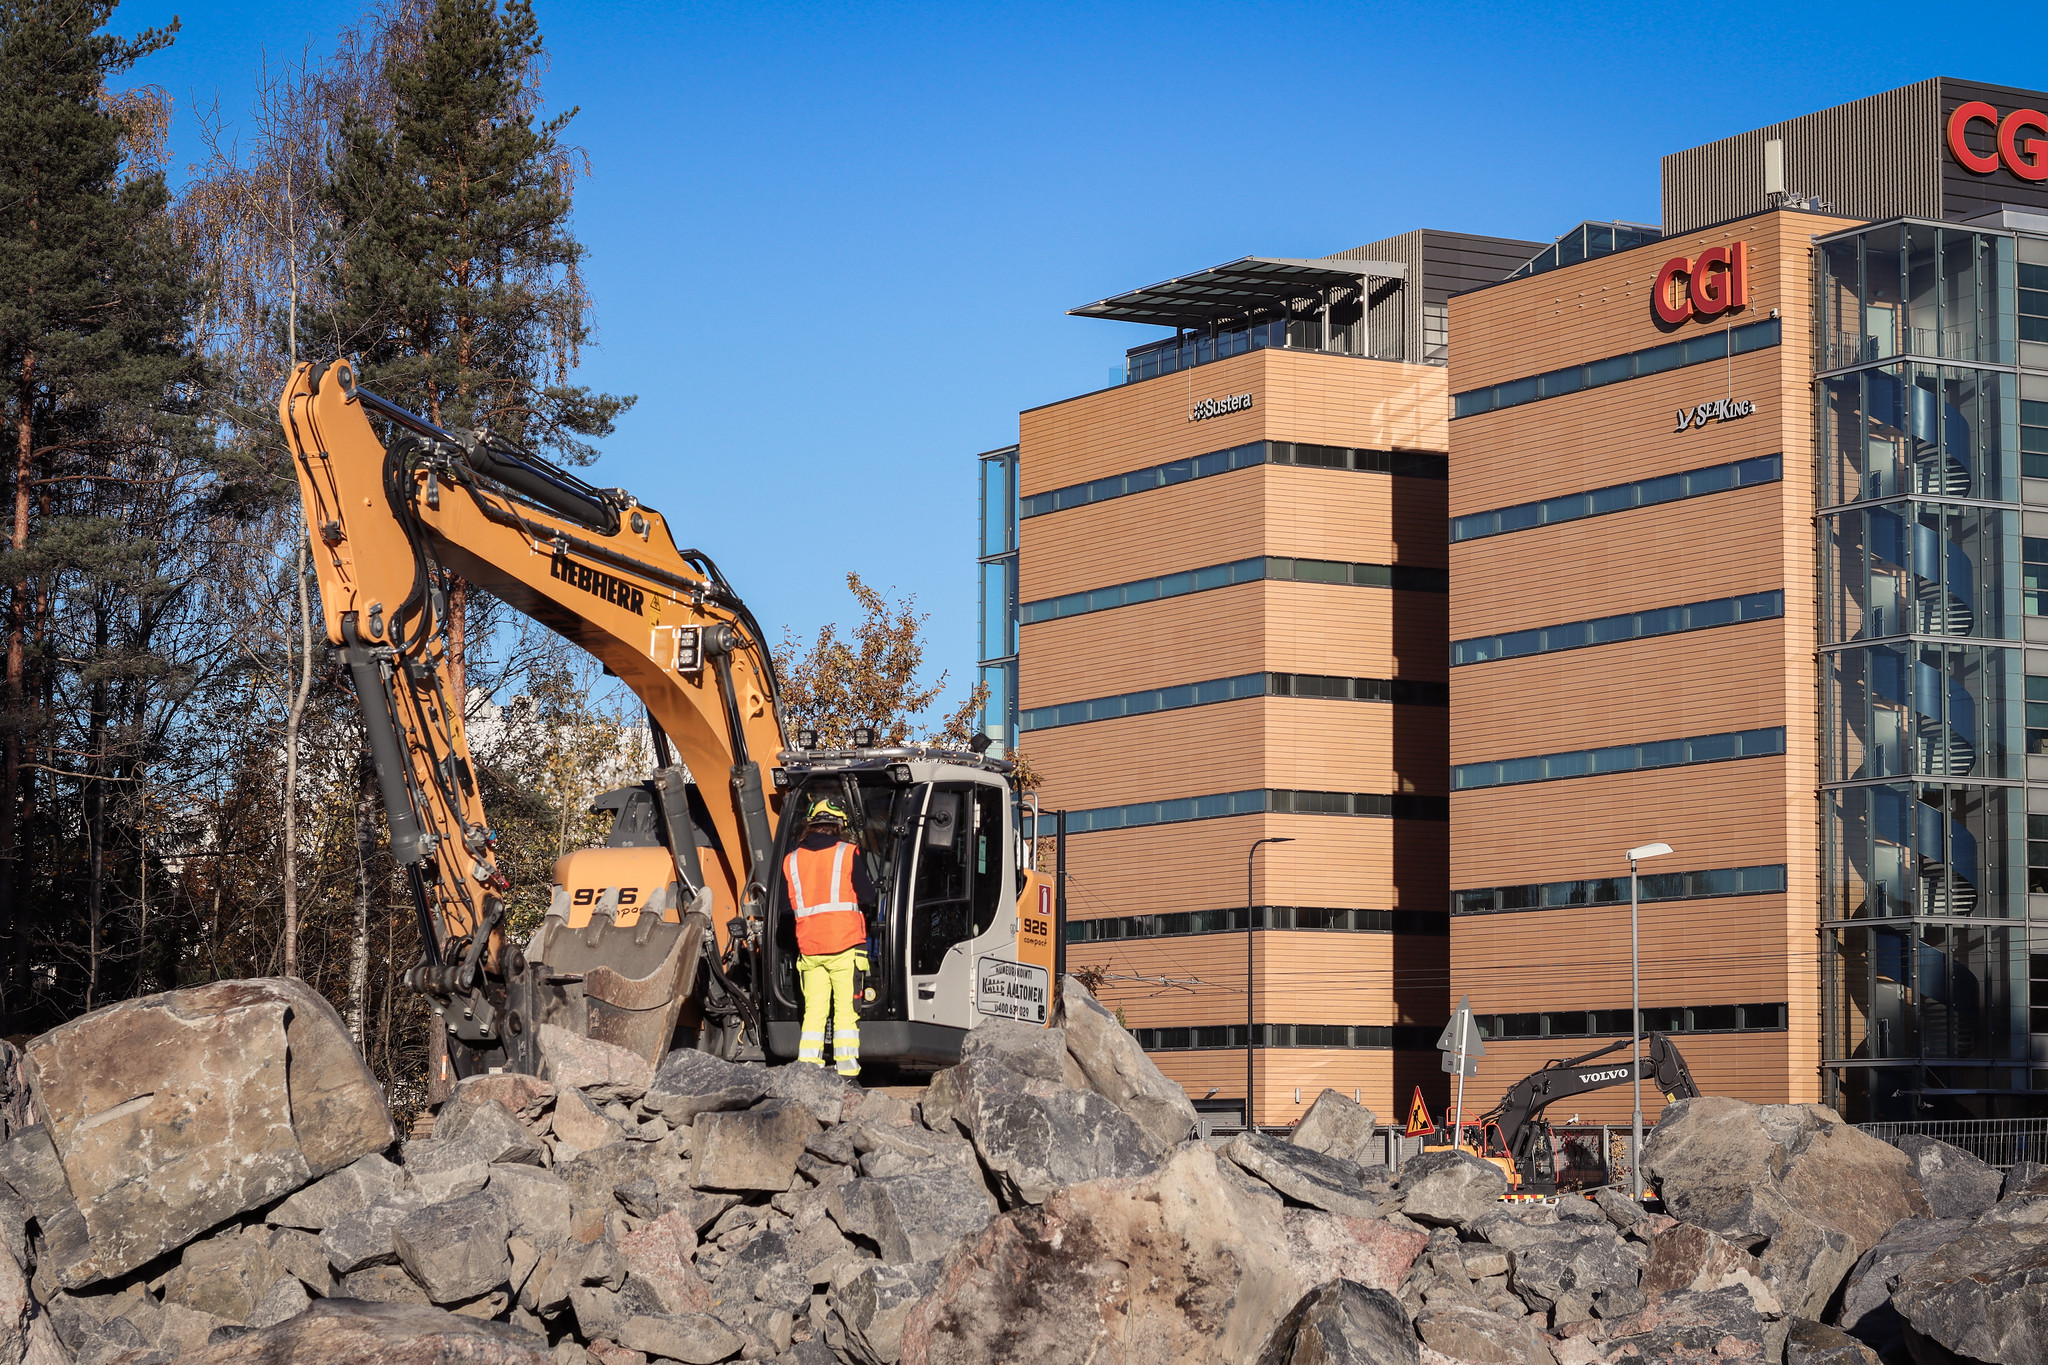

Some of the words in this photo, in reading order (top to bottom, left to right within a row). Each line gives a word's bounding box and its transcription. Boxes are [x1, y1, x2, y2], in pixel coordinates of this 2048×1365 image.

[1654, 241, 1748, 323] CGI
[1205, 393, 1251, 417] Sustera
[550, 553, 645, 616] LIEBHERR
[1024, 918, 1047, 936] 926
[1024, 937, 1047, 947] compact
[1579, 1069, 1628, 1083] VOLVO
